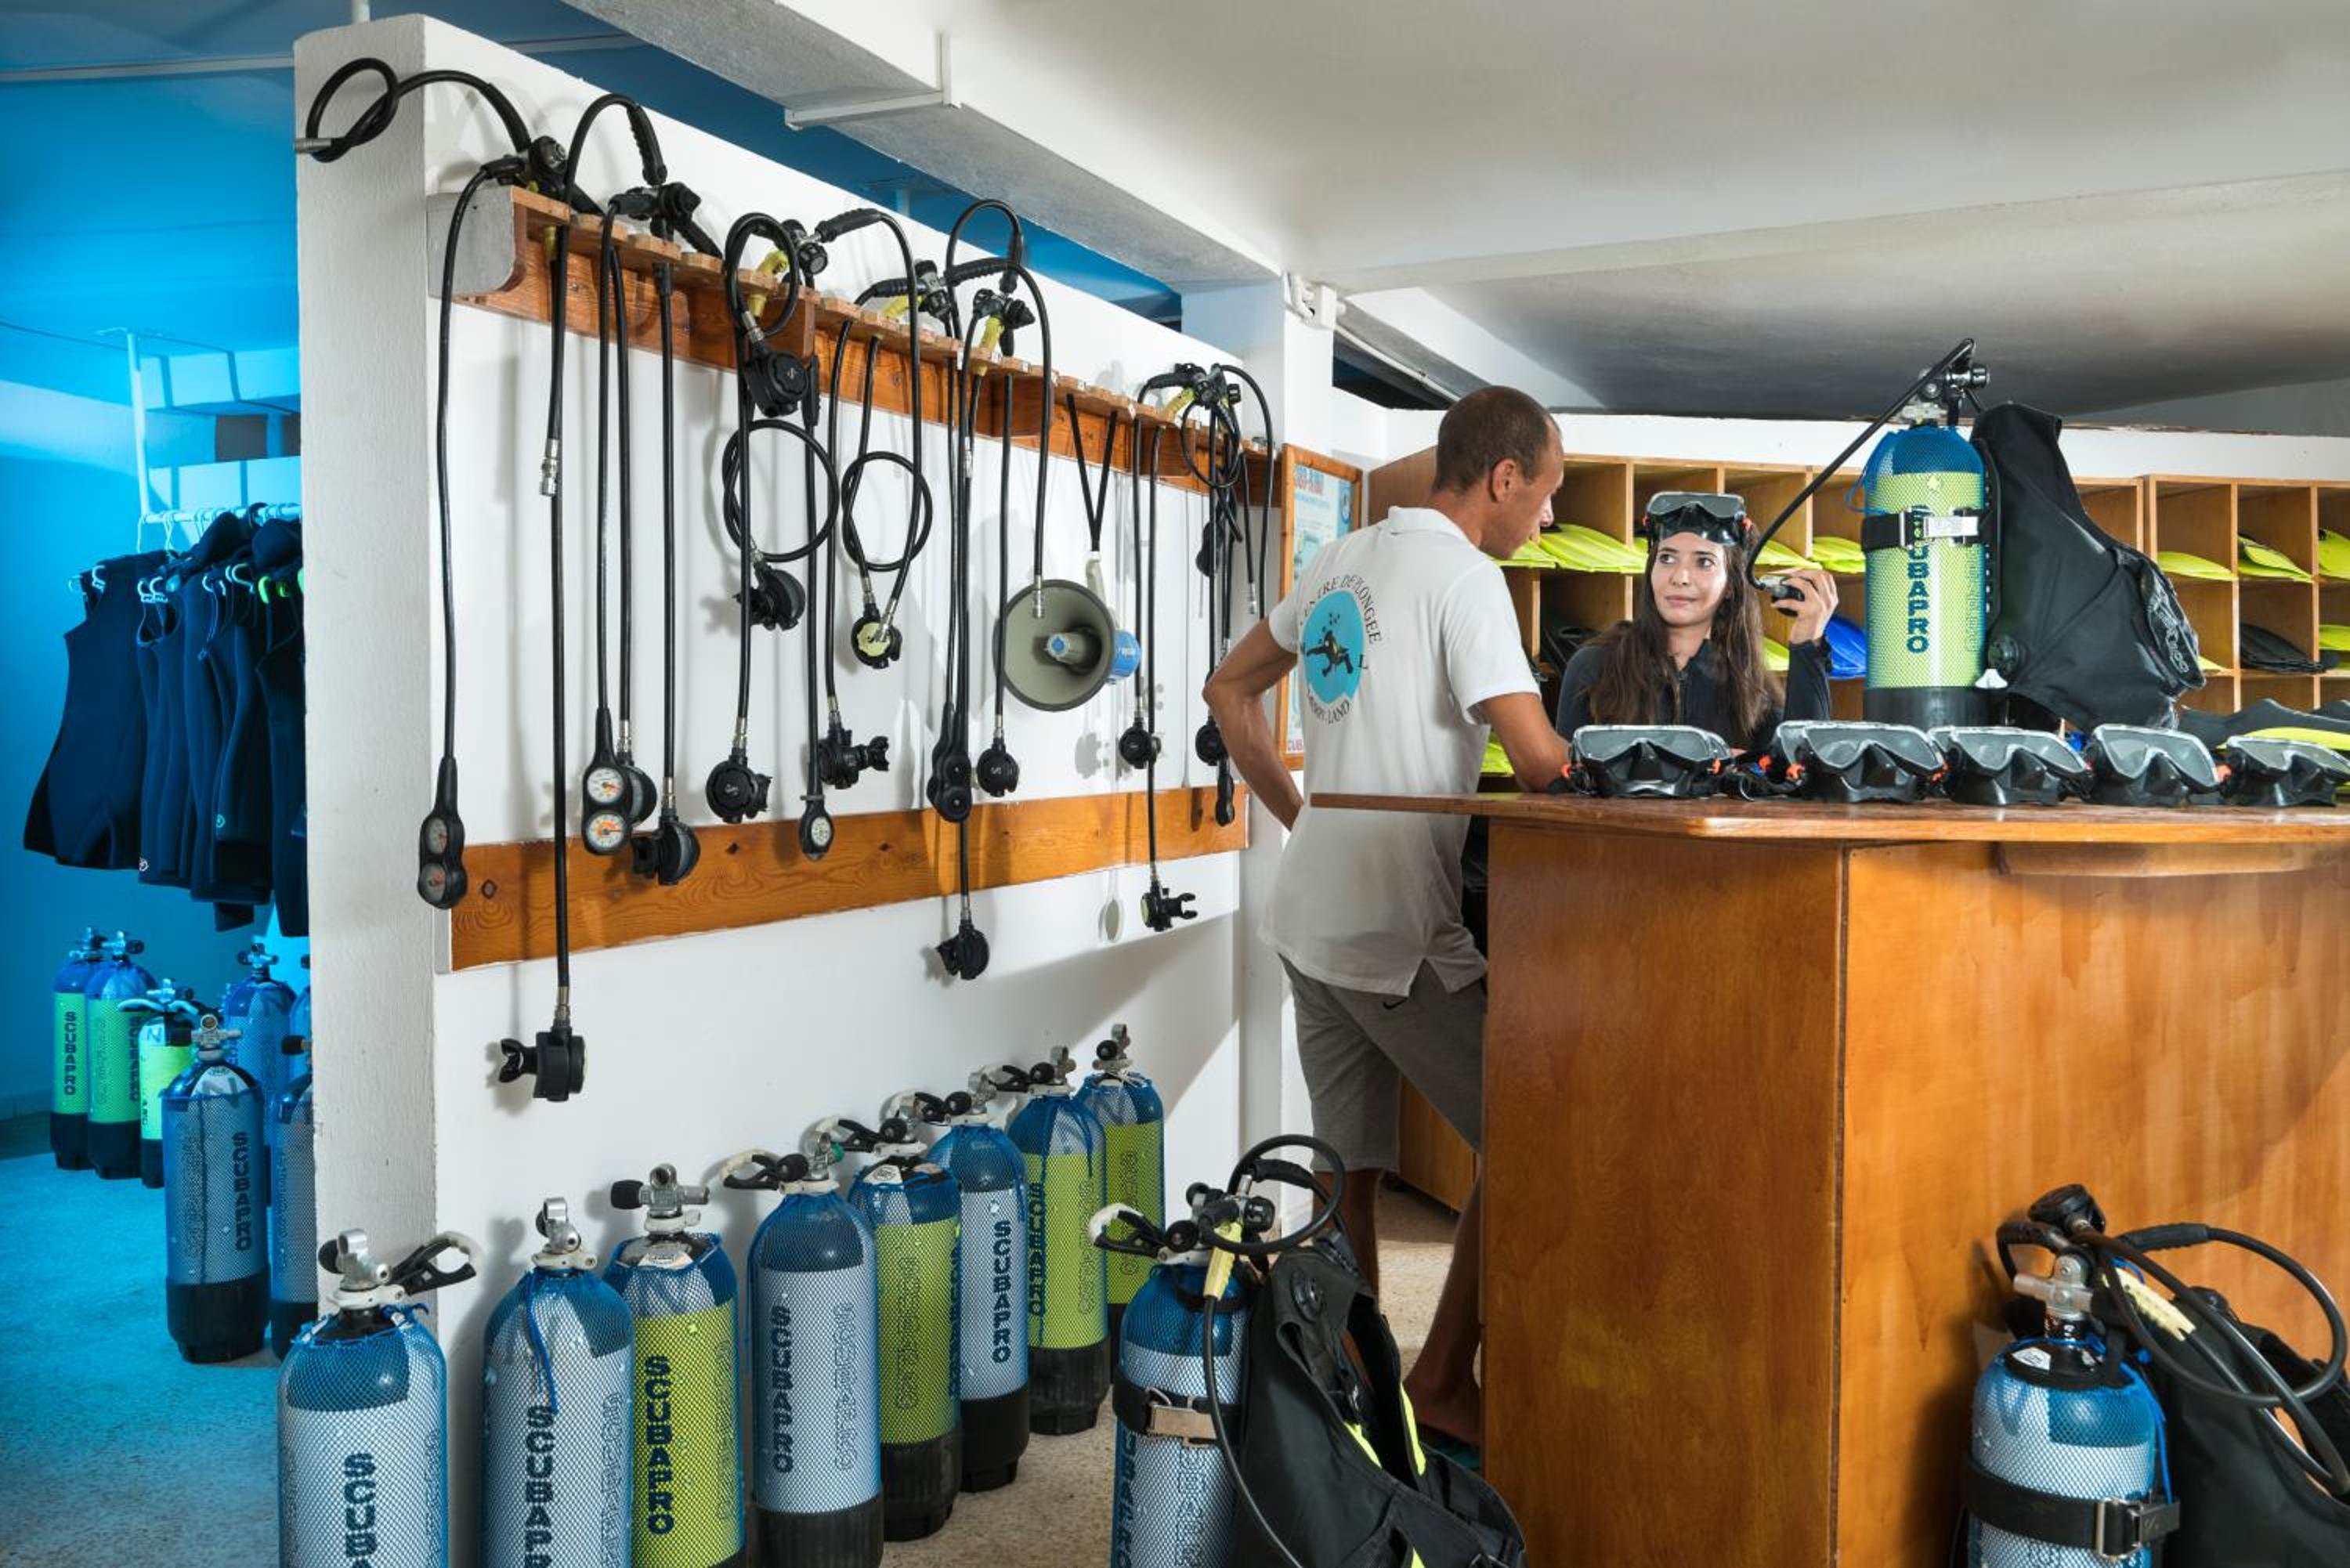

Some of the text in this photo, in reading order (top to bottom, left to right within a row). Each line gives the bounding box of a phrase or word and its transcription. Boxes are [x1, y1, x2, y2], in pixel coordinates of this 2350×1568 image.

[1906, 504, 1930, 653] UBAPRO
[64, 1011, 77, 1096] SCUBAPRO
[233, 1132, 251, 1252] SCUBAPRO
[992, 1219, 1012, 1364] SCUBAPRO
[642, 1353, 675, 1535] SCUBAPRO
[770, 1304, 794, 1474] SCUBAPRO
